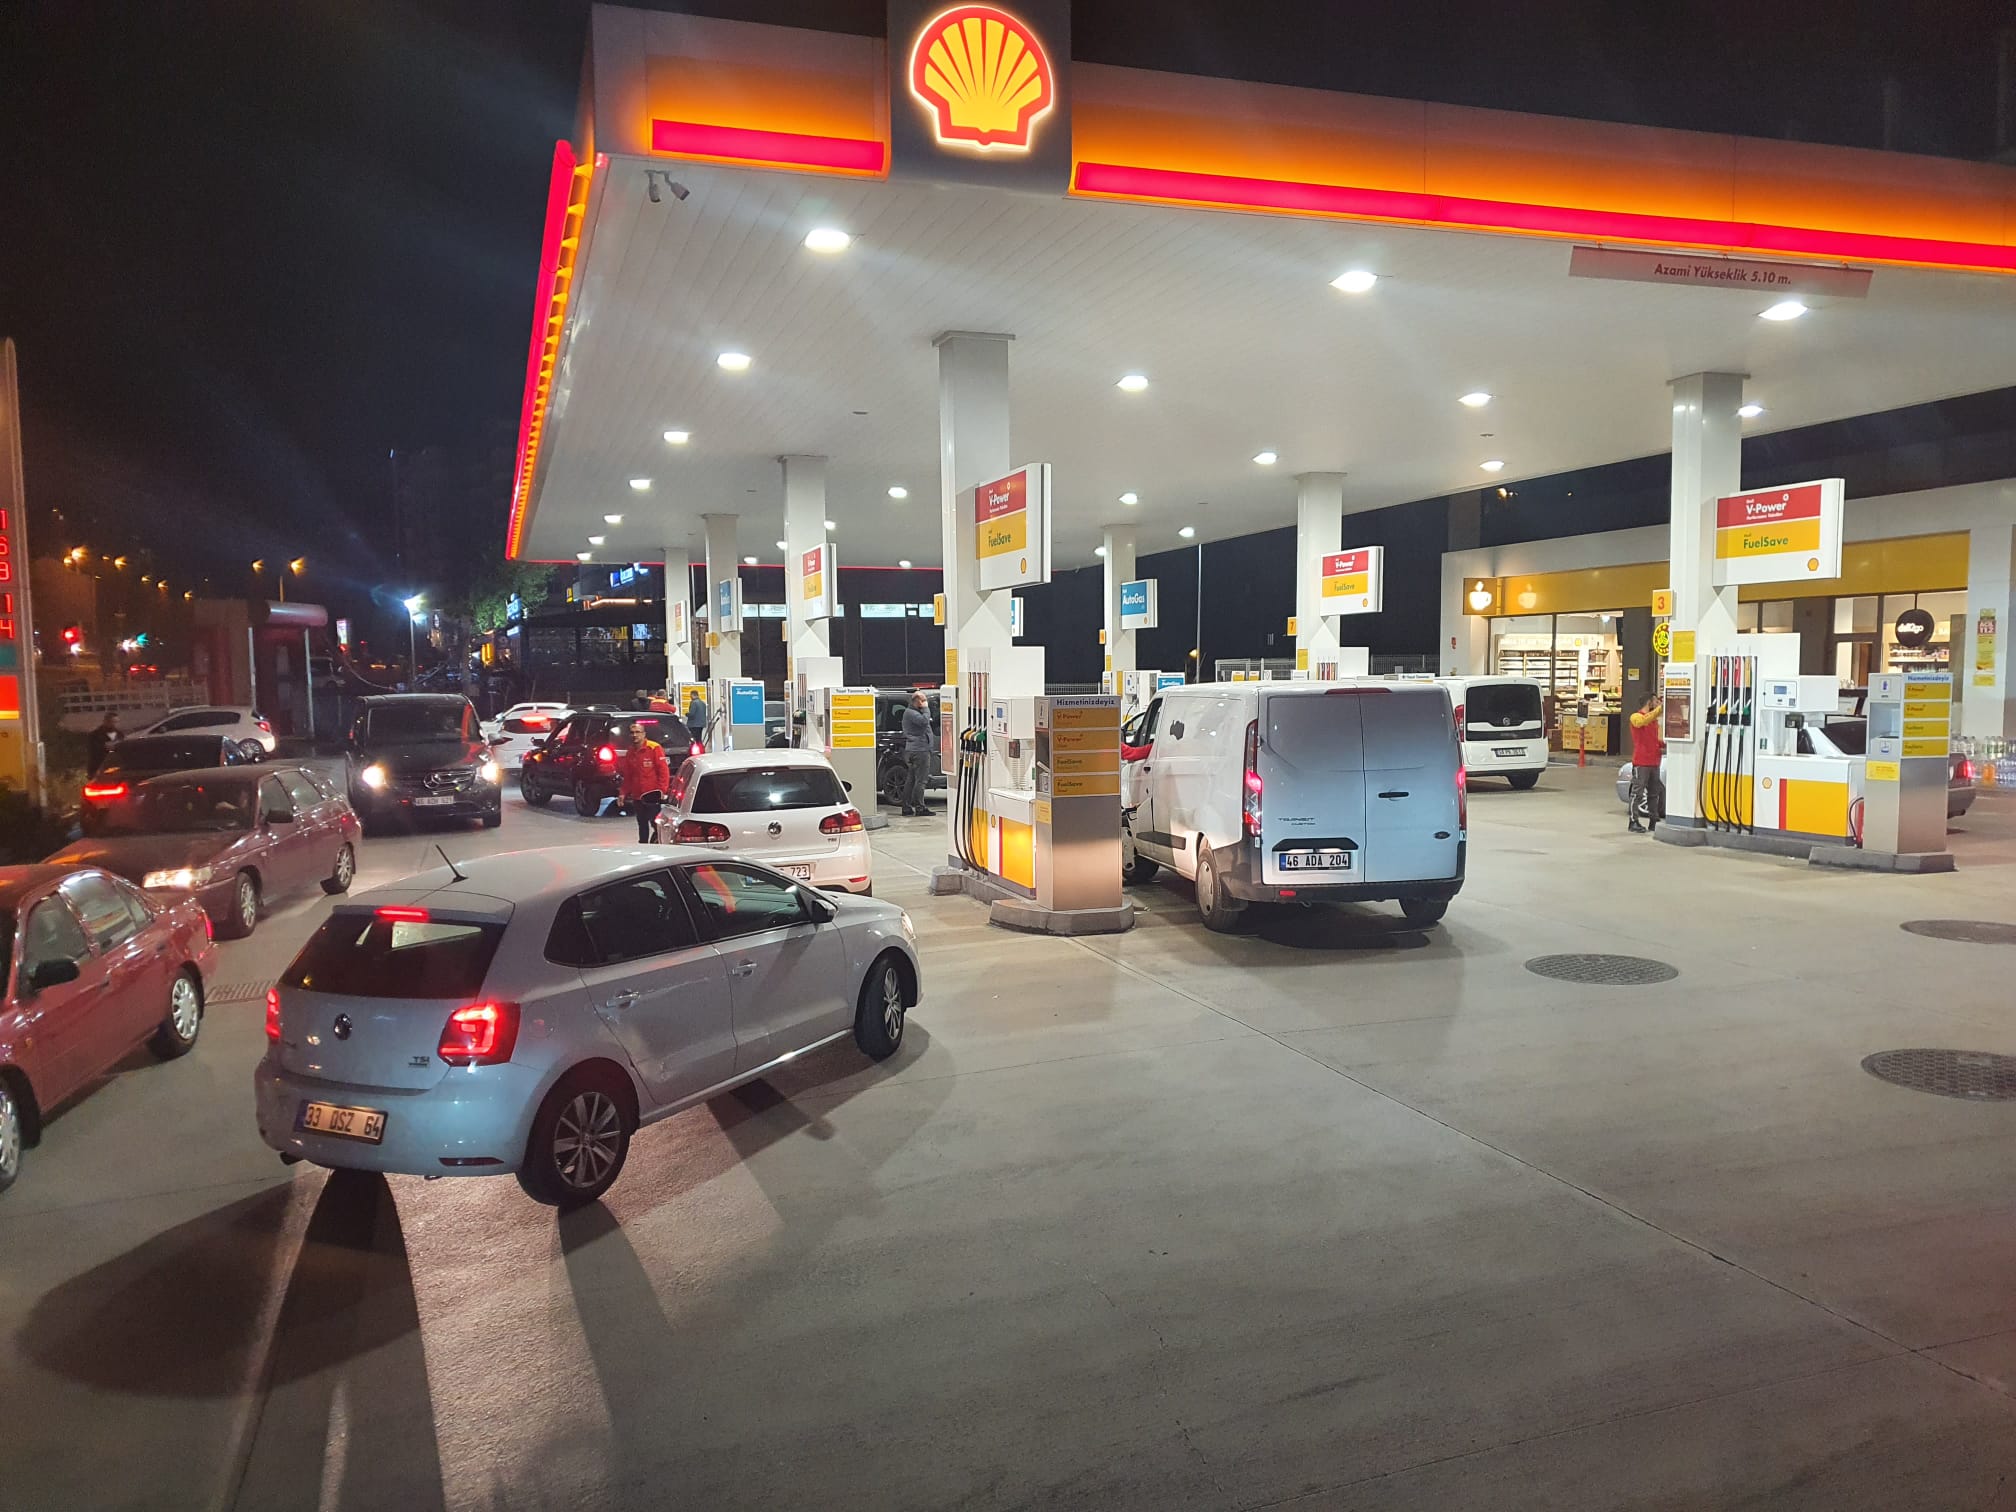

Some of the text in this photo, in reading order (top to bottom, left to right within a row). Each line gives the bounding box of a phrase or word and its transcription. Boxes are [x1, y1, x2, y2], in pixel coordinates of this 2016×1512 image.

[1654, 262, 1792, 285] Azami Yükseklik 5.10 m.
[1746, 503, 1787, 514] V-Power
[1743, 536, 1788, 549] FuelSave
[1657, 596, 1665, 610] 3
[1290, 621, 1295, 632] 7
[1287, 854, 1347, 867] 46 ADA 204
[790, 866, 808, 877] 723
[305, 1106, 321, 1127] 33
[364, 1115, 380, 1137] 64
